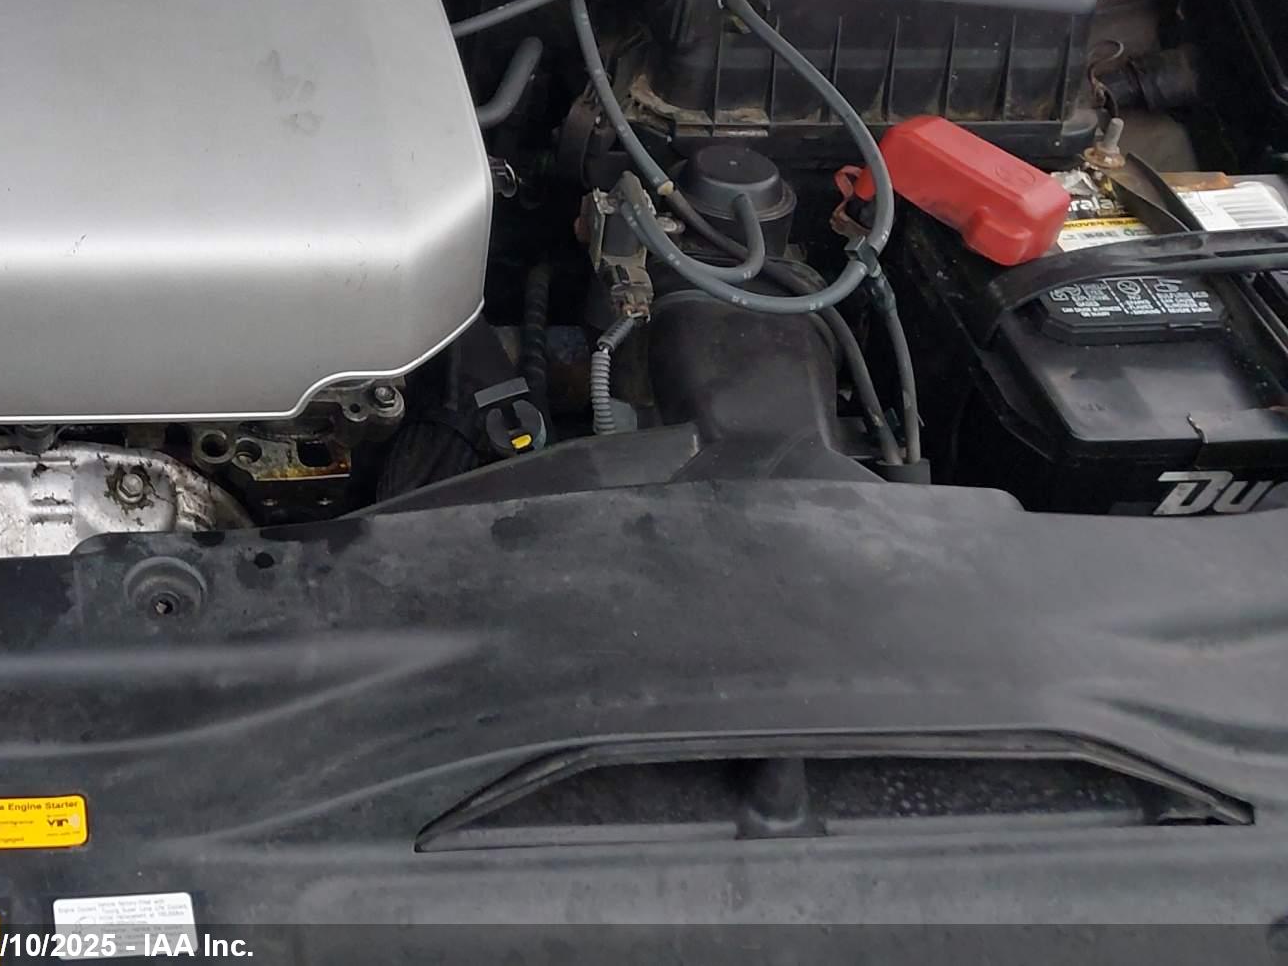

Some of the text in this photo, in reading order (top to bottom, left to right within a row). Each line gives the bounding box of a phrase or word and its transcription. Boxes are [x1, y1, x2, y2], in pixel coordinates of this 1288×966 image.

[1067, 195, 1116, 212] rala
[1153, 470, 1273, 514] Du
[8, 802, 42, 812] Engine
[45, 801, 78, 811] Starter
